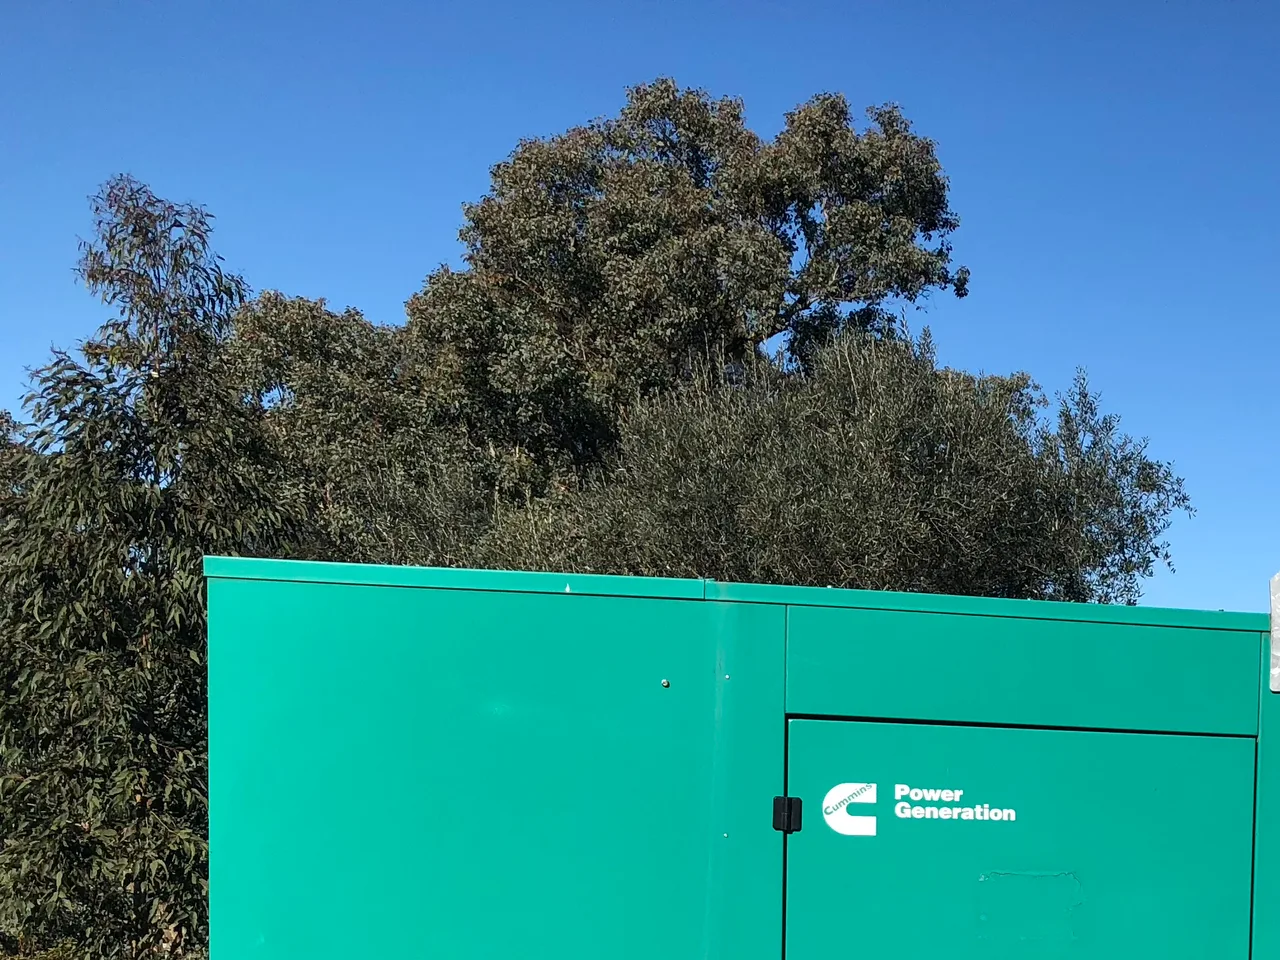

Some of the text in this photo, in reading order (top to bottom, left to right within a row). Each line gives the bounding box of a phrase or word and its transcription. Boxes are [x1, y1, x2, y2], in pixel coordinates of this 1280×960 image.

[823, 782, 873, 816] Cummins
[894, 784, 963, 802] Power
[894, 802, 1016, 821] Generation
